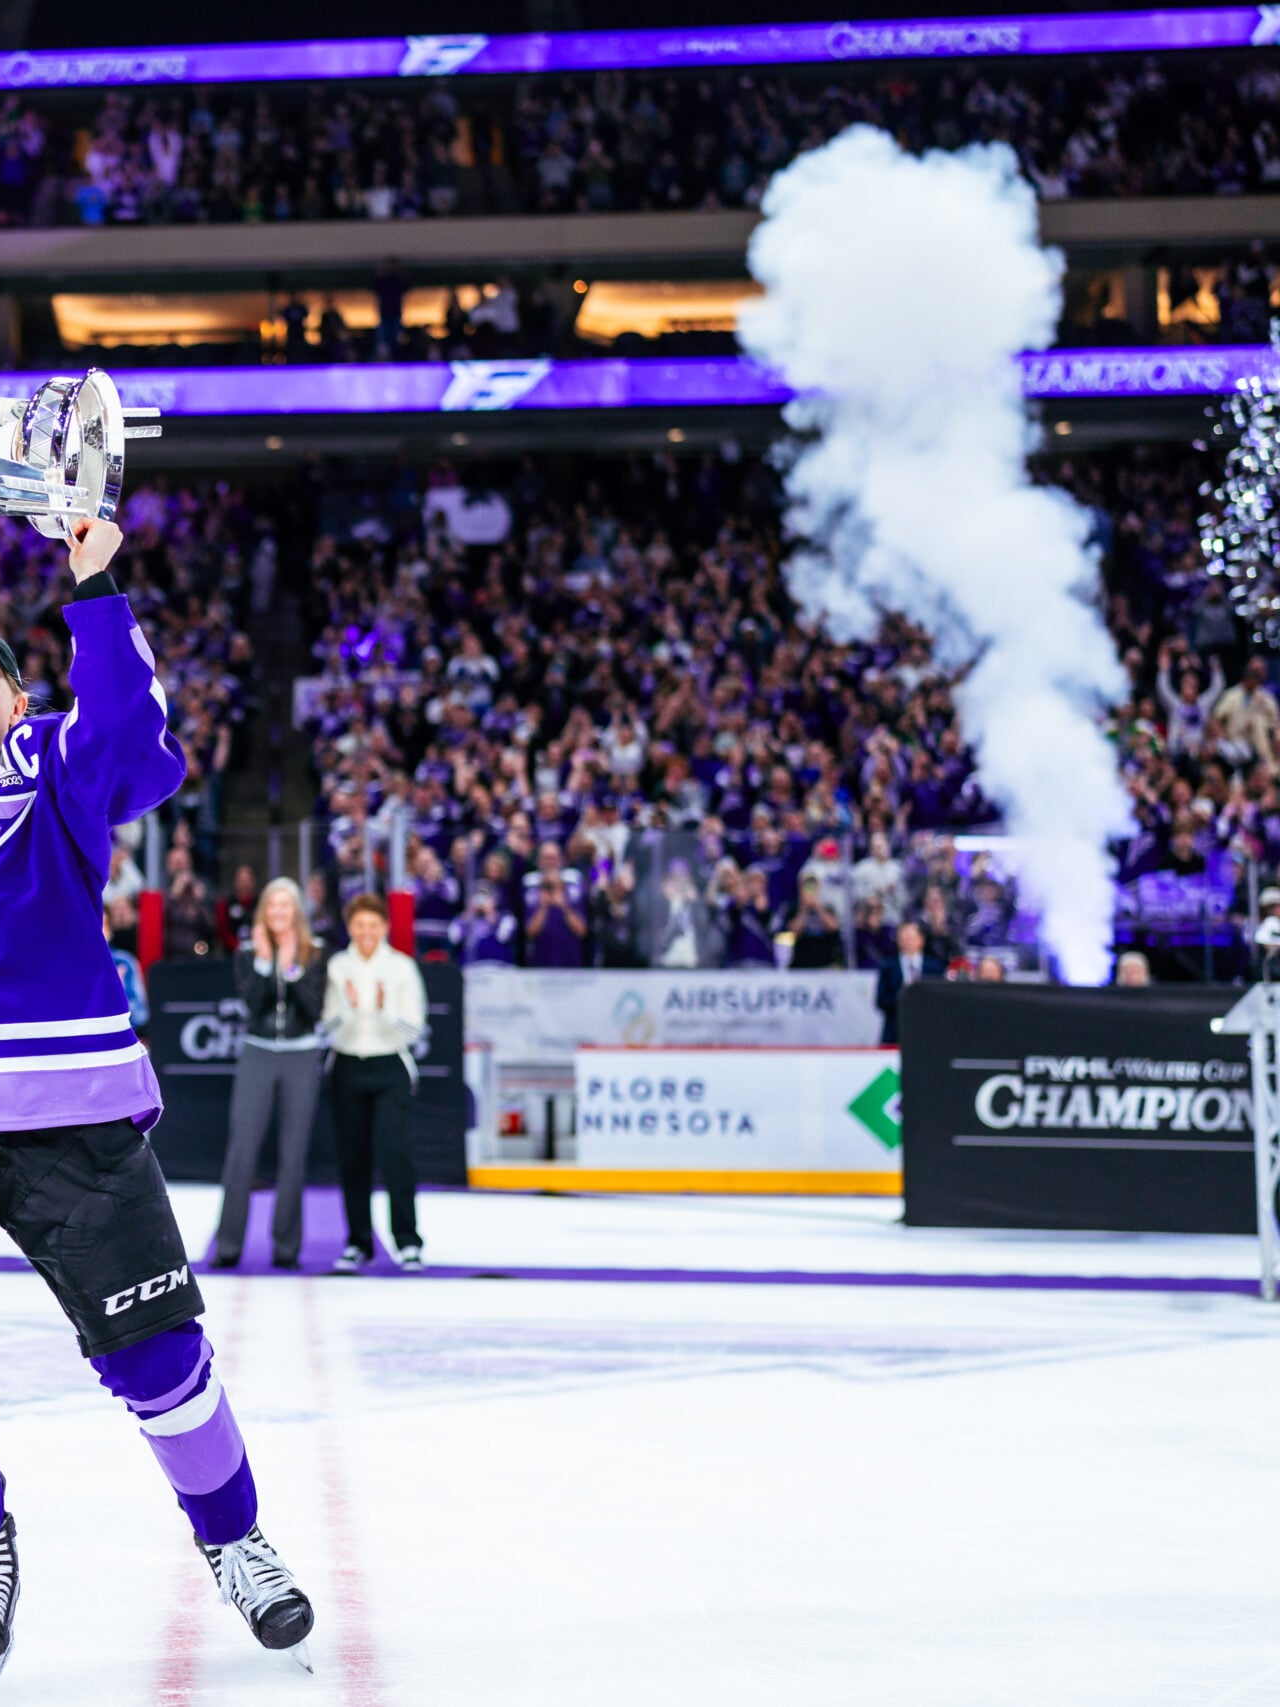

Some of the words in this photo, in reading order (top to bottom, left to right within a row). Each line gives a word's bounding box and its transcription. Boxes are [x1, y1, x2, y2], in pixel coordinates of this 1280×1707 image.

[1020, 359, 1228, 392] HAMPIONS
[9, 724, 40, 779] C
[664, 986, 834, 1014] AIRSUPRA
[975, 1074, 1255, 1131] CHAMPION
[102, 1264, 188, 1316] CCM
